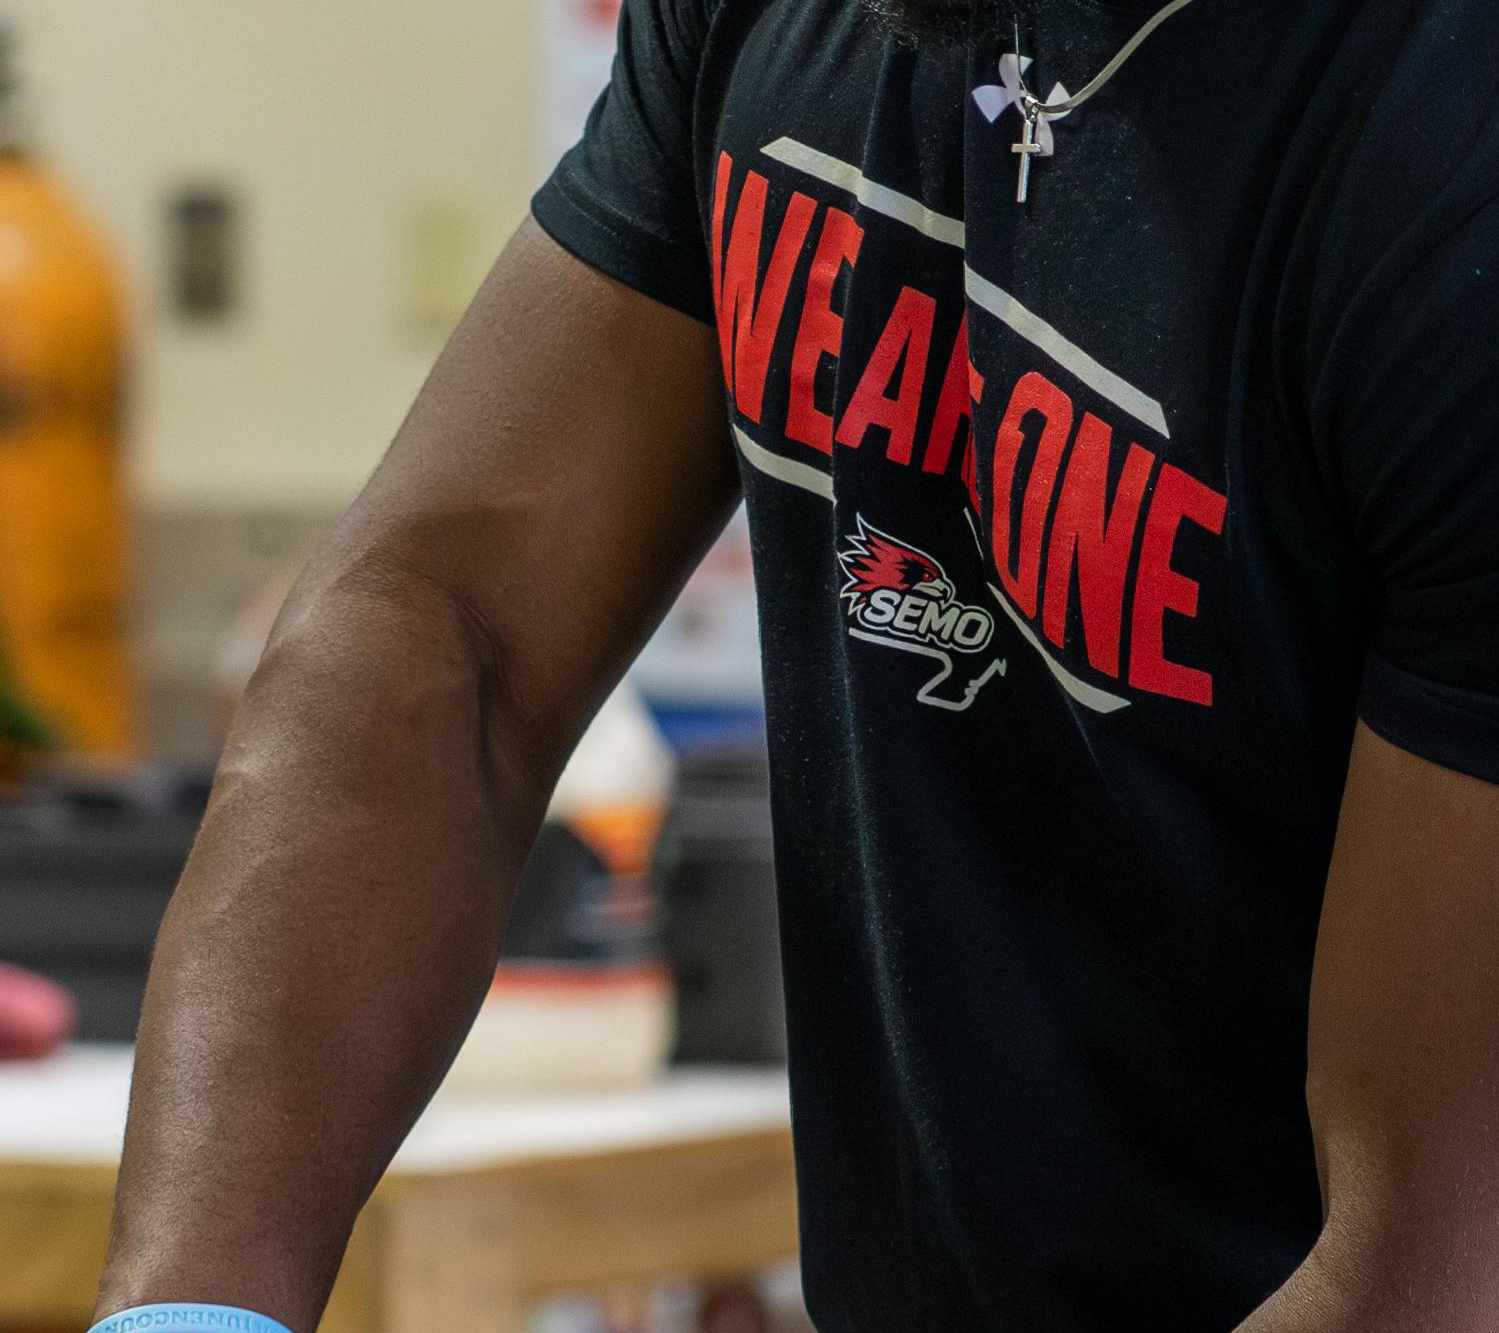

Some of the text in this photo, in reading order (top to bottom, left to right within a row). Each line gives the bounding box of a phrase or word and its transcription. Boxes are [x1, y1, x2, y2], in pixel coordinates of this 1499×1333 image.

[711, 149, 865, 457] WE
[992, 371, 1229, 707] ONE
[863, 589, 990, 646] SEMO
